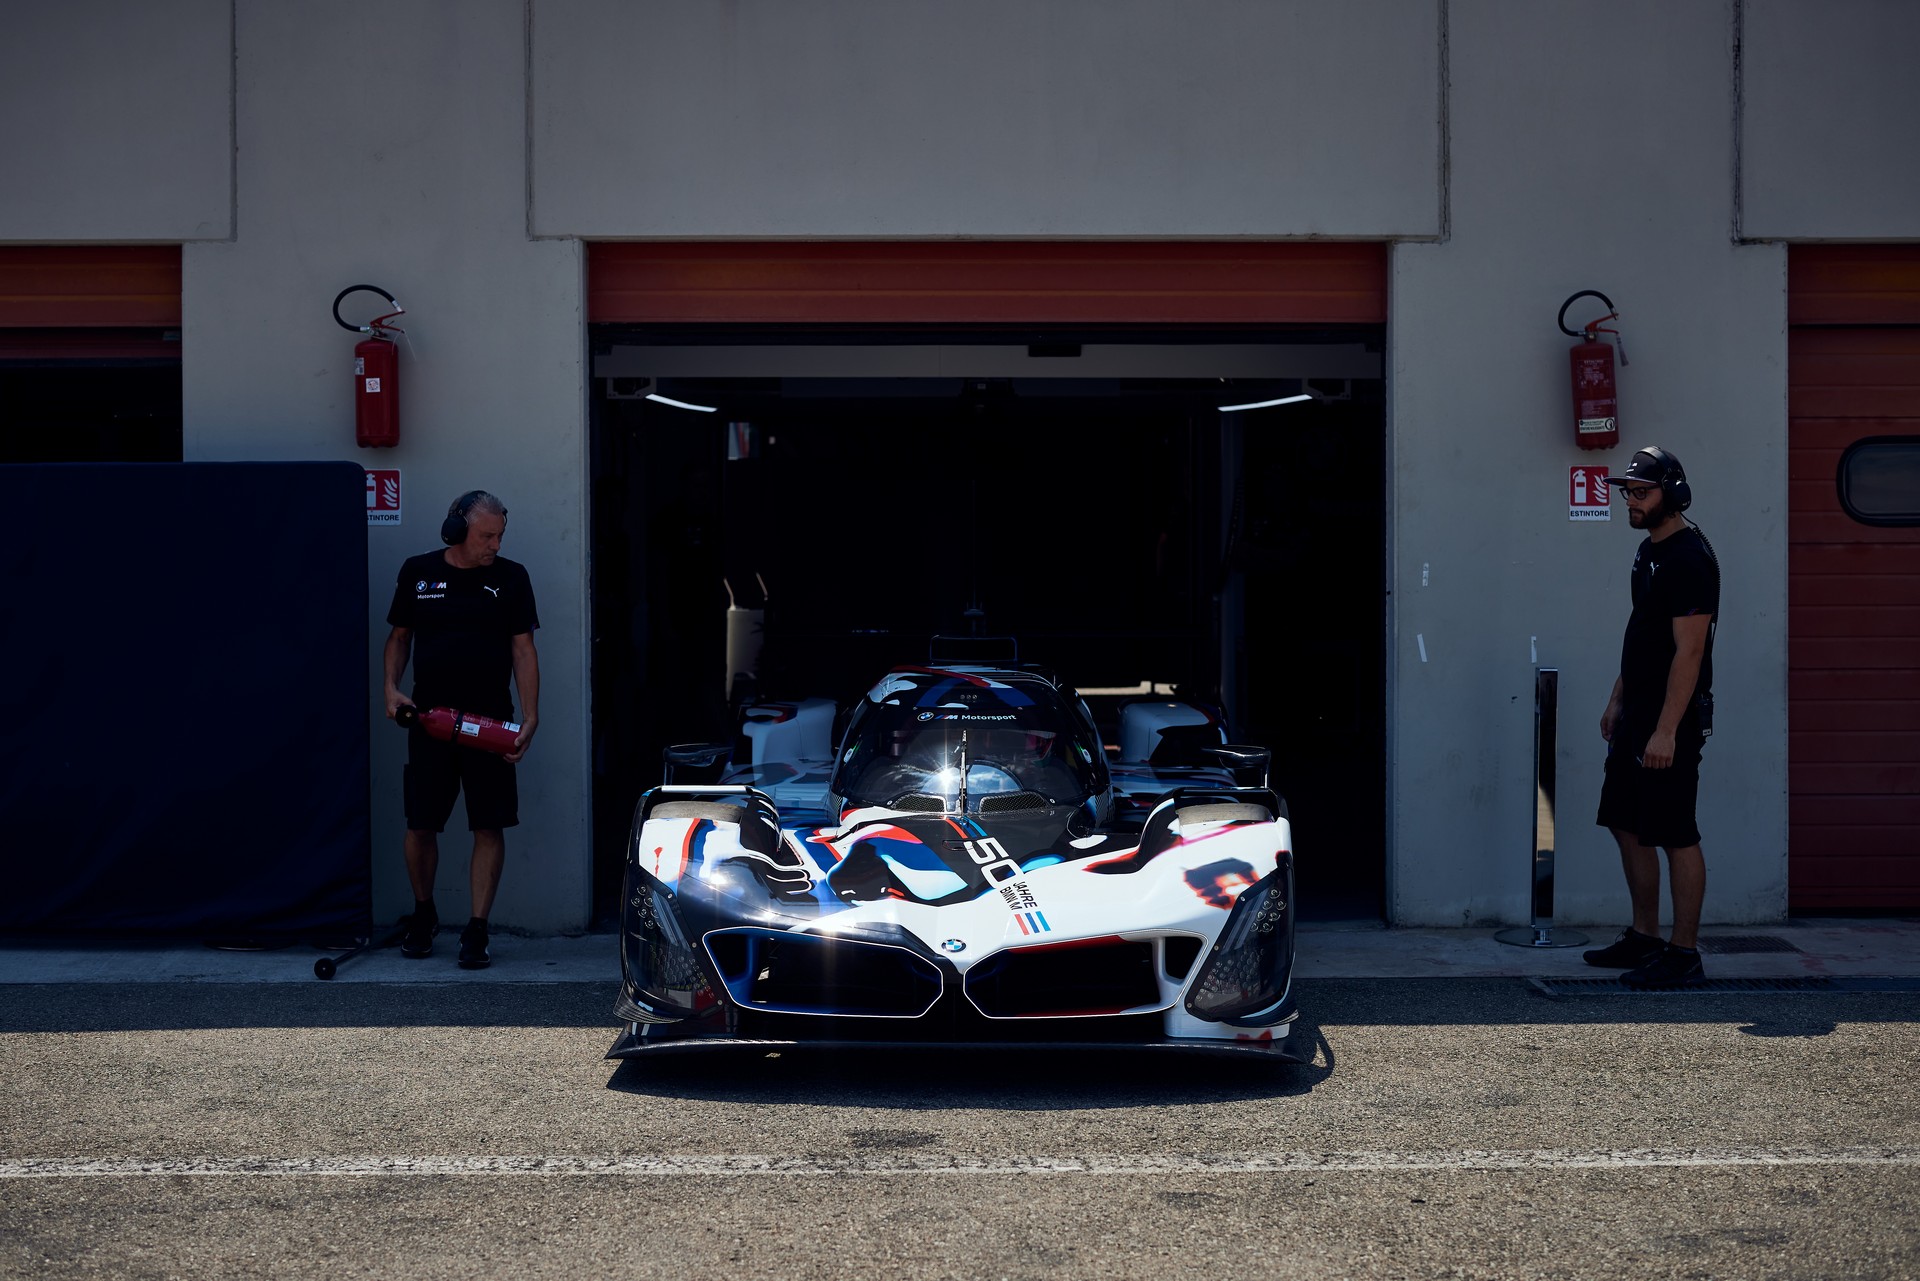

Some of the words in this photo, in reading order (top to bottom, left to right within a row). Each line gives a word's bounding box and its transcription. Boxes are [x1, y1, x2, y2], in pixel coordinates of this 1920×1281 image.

[963, 837, 1026, 891] 50
[999, 886, 1018, 904] BMW
[1008, 901, 1023, 911] M
[1012, 881, 1038, 909] JAHRE
